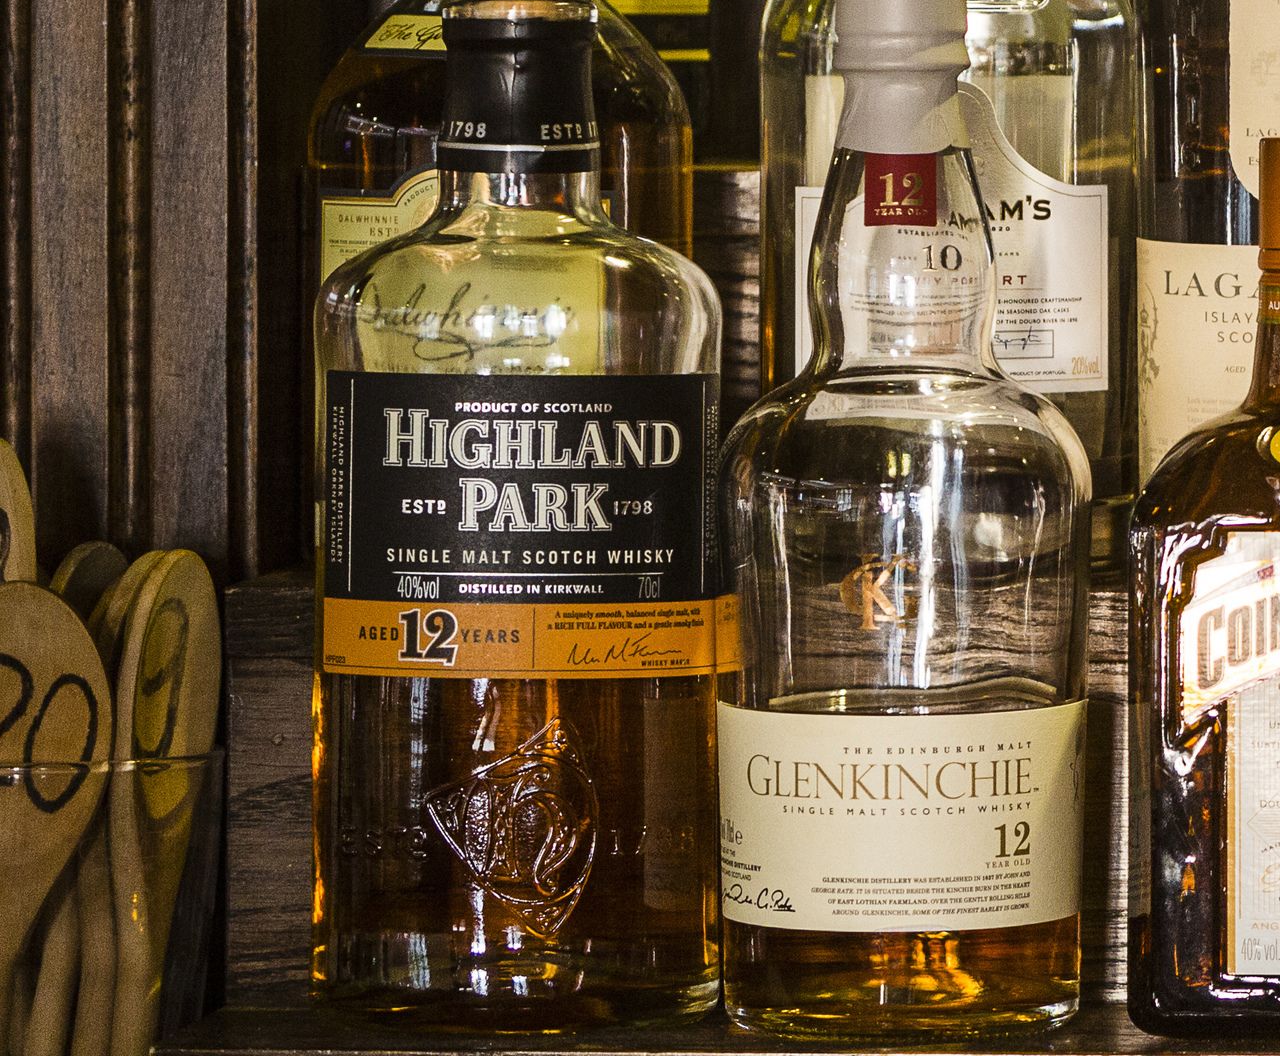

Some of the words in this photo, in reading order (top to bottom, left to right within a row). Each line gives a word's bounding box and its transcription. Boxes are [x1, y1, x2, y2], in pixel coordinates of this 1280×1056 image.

[449, 122, 486, 138] 1798
[880, 173, 924, 206] 12
[339, 214, 398, 225] DALWHINNIE
[922, 245, 962, 272] 10
[455, 403, 519, 413] PRODUCT
[522, 403, 539, 413] OF
[544, 402, 612, 413] SCOTLAND
[383, 408, 681, 469] HIGHLAND
[458, 478, 612, 532] PARK
[613, 500, 653, 515] 1798
[387, 548, 451, 563] SINGLE
[462, 549, 512, 564] MALT
[522, 549, 596, 565] SCOTCH
[607, 549, 674, 564] WHISKY
[458, 583, 523, 594] DISTILLED
[526, 584, 540, 593] IN
[544, 583, 604, 594] KIRKWALL
[359, 626, 398, 641] AGED
[398, 608, 458, 666] 12
[461, 629, 520, 643] YEARS
[843, 746, 873, 754] THE
[887, 744, 986, 754] EDINBURGH
[998, 741, 1032, 751] MALT
[746, 754, 1032, 801] GLENKINCHIE
[783, 805, 835, 815] SINGLE
[847, 807, 886, 816] MALT
[901, 807, 966, 816] SCOTCH
[978, 802, 1032, 813] WHISKY
[994, 822, 1031, 858] 12
